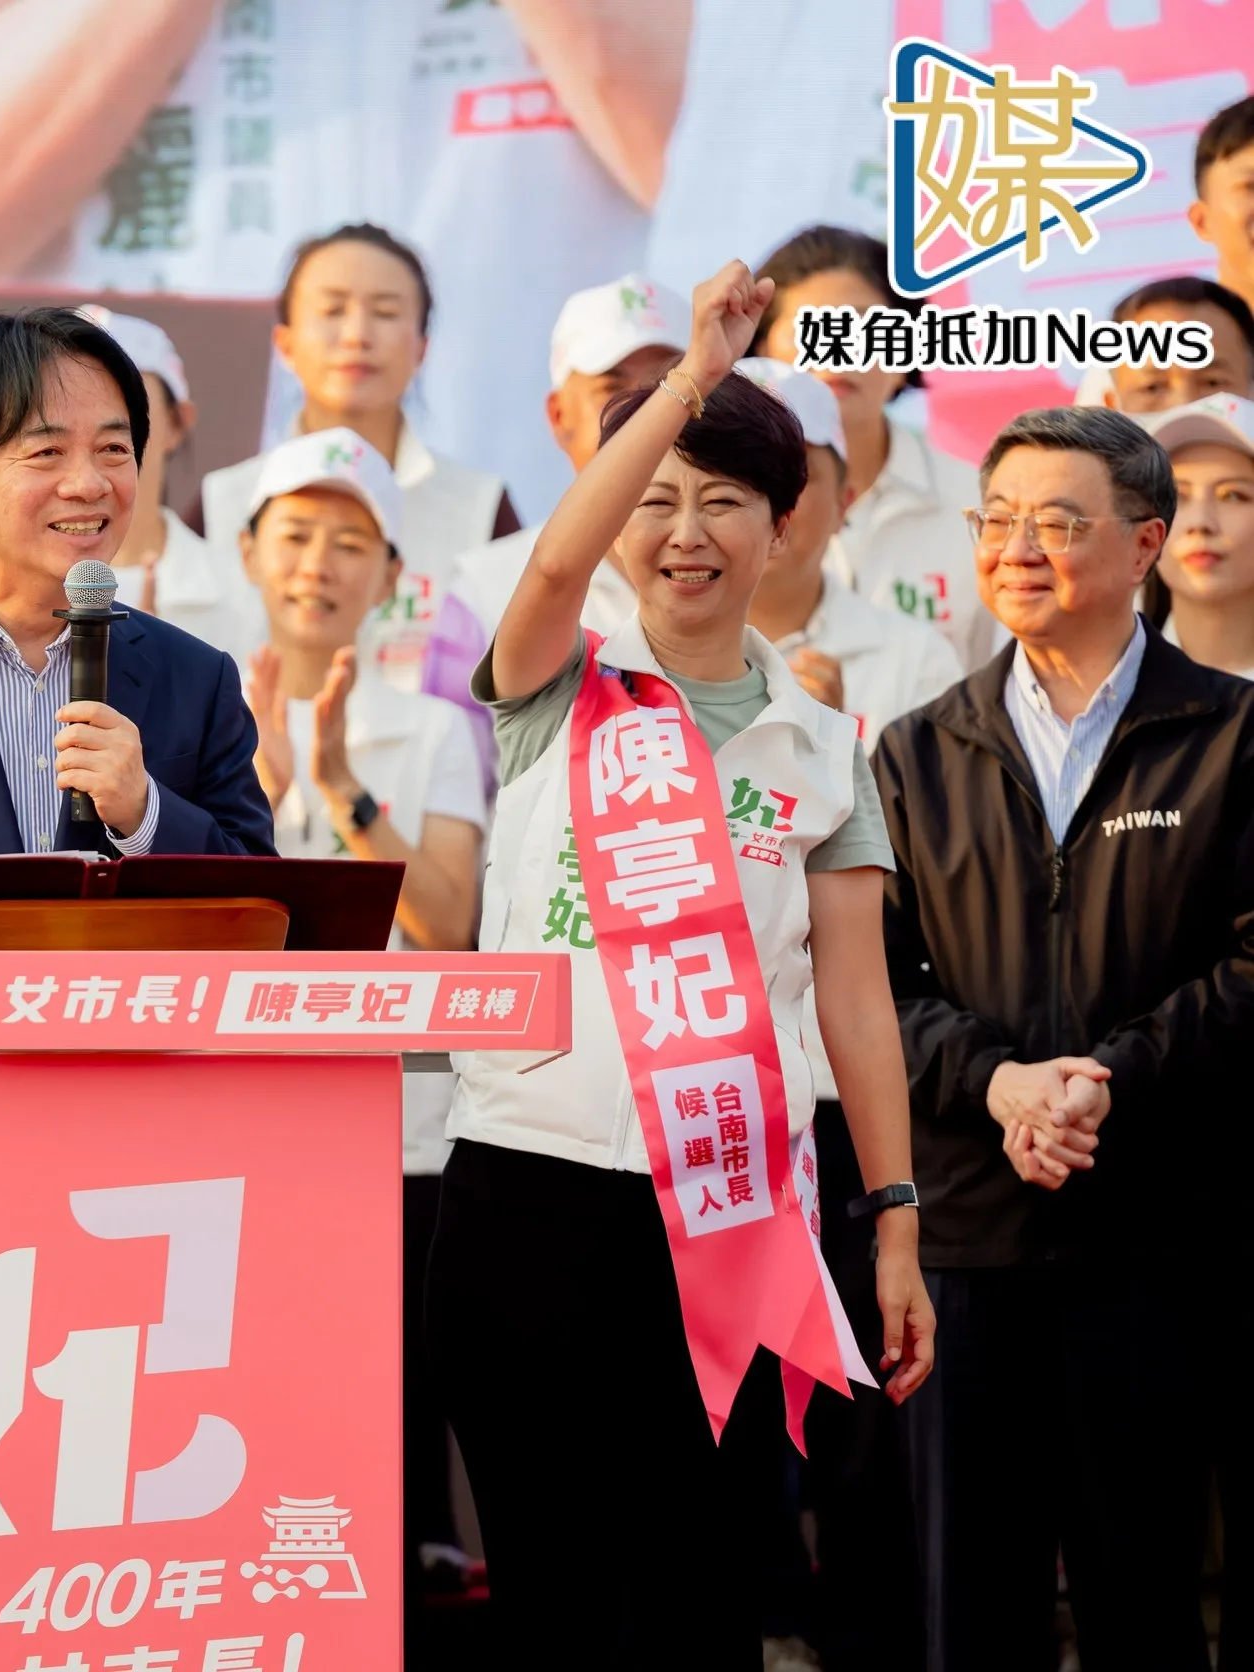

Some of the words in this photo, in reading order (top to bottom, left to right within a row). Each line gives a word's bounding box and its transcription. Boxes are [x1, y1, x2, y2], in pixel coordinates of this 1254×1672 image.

[589, 705, 748, 1052] 陳亭妃
[1102, 810, 1181, 837] TAIWAN
[245, 981, 413, 1023] 陳亭妃
[446, 987, 517, 1020] 接棒
[674, 1086, 724, 1217] 候選人
[711, 1081, 755, 1207] 台南市長
